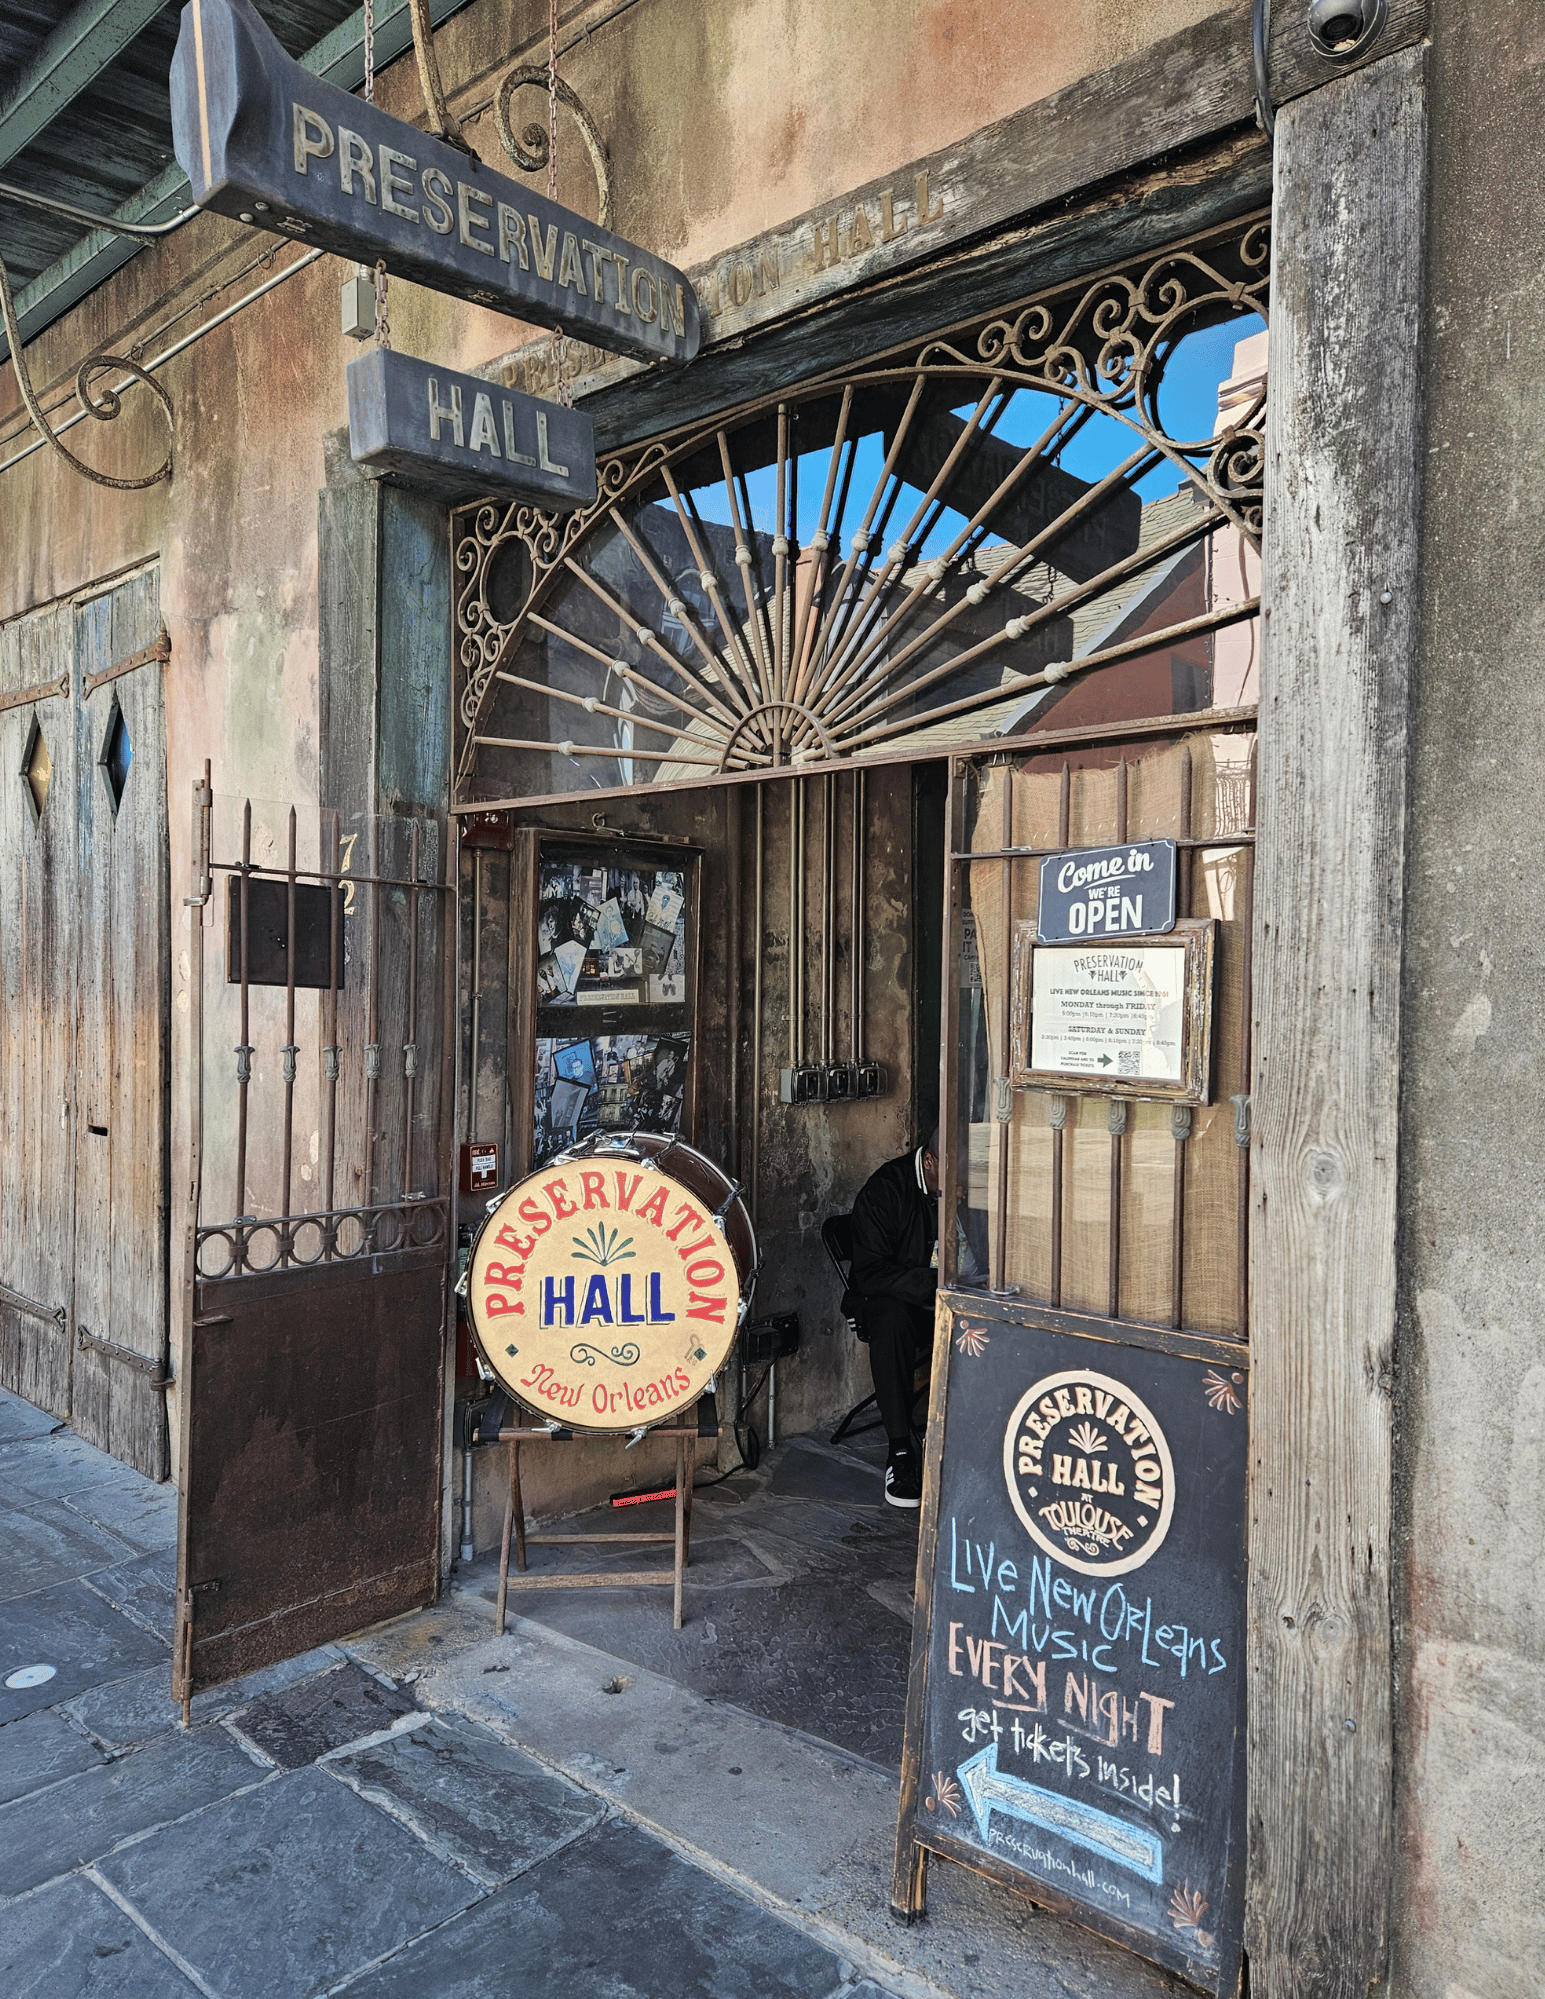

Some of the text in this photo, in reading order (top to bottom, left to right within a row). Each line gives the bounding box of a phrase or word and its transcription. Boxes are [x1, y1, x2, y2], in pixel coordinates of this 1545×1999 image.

[292, 102, 685, 338] PRESERVATION
[812, 169, 944, 274] HALL
[428, 377, 570, 477] HALL
[1057, 848, 1154, 893] Come in
[1088, 885, 1120, 900] WE'RE
[964, 928, 977, 939] PA
[1068, 894, 1143, 934] OPEN
[1073, 954, 1144, 973] PRESERVATION
[1098, 970, 1120, 982] HALL
[1096, 1002, 1123, 1011] through
[1068, 1025, 1106, 1034] SATURDAY
[1115, 1028, 1146, 1036] SUNDAY
[484, 1170, 728, 1325] PRESERVATION
[540, 1272, 676, 1329] HALL
[520, 1363, 691, 1414] New Orleans
[1018, 1386, 1161, 1510] PRESERVATION
[1051, 1454, 1125, 1496] HALL
[1081, 1492, 1094, 1503] AT
[1038, 1501, 1134, 1551] TOULOUSE
[1062, 1526, 1111, 1548] THEATRE
[949, 1621, 1175, 1755] EVERY NIGHT
[957, 1706, 1181, 1833] get tickets inside!
